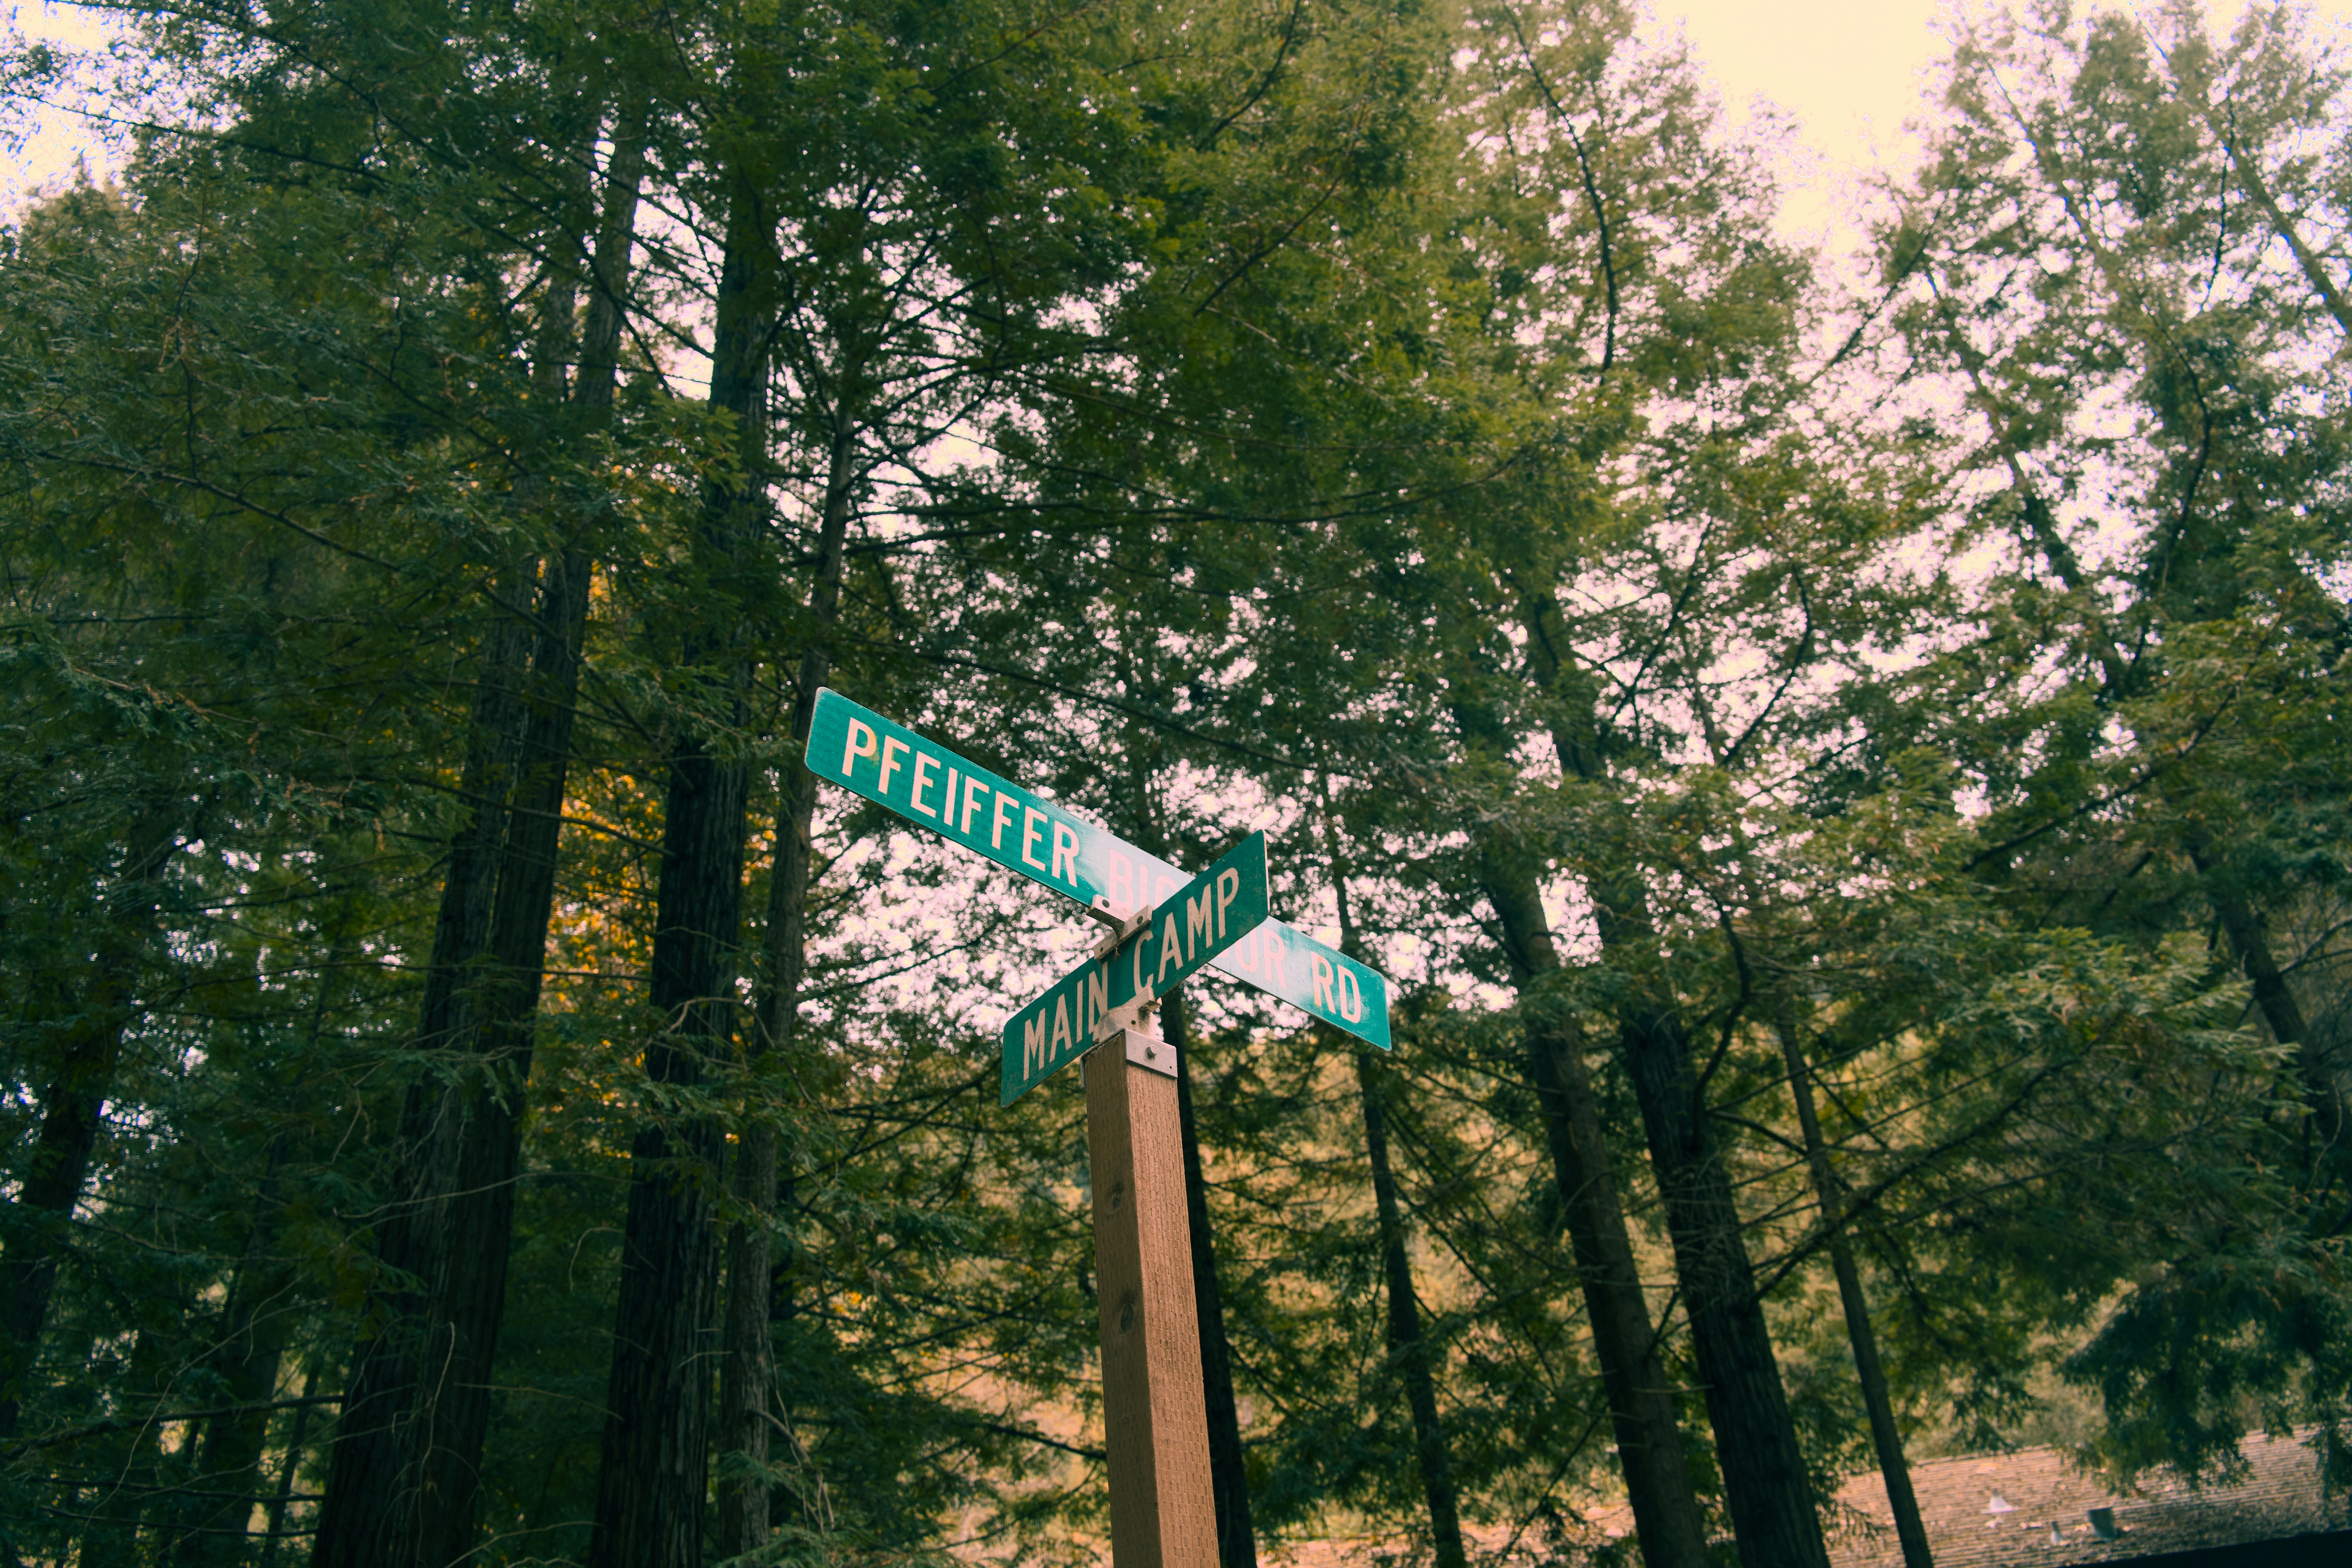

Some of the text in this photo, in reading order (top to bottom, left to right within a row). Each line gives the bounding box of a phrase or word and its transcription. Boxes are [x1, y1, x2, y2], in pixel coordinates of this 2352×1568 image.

[842, 717, 1077, 887] PFEIFFER
[1218, 927, 1287, 989] UR
[1311, 951, 1361, 1024] RD
[1024, 867, 1239, 1081] MAIN CAMP
